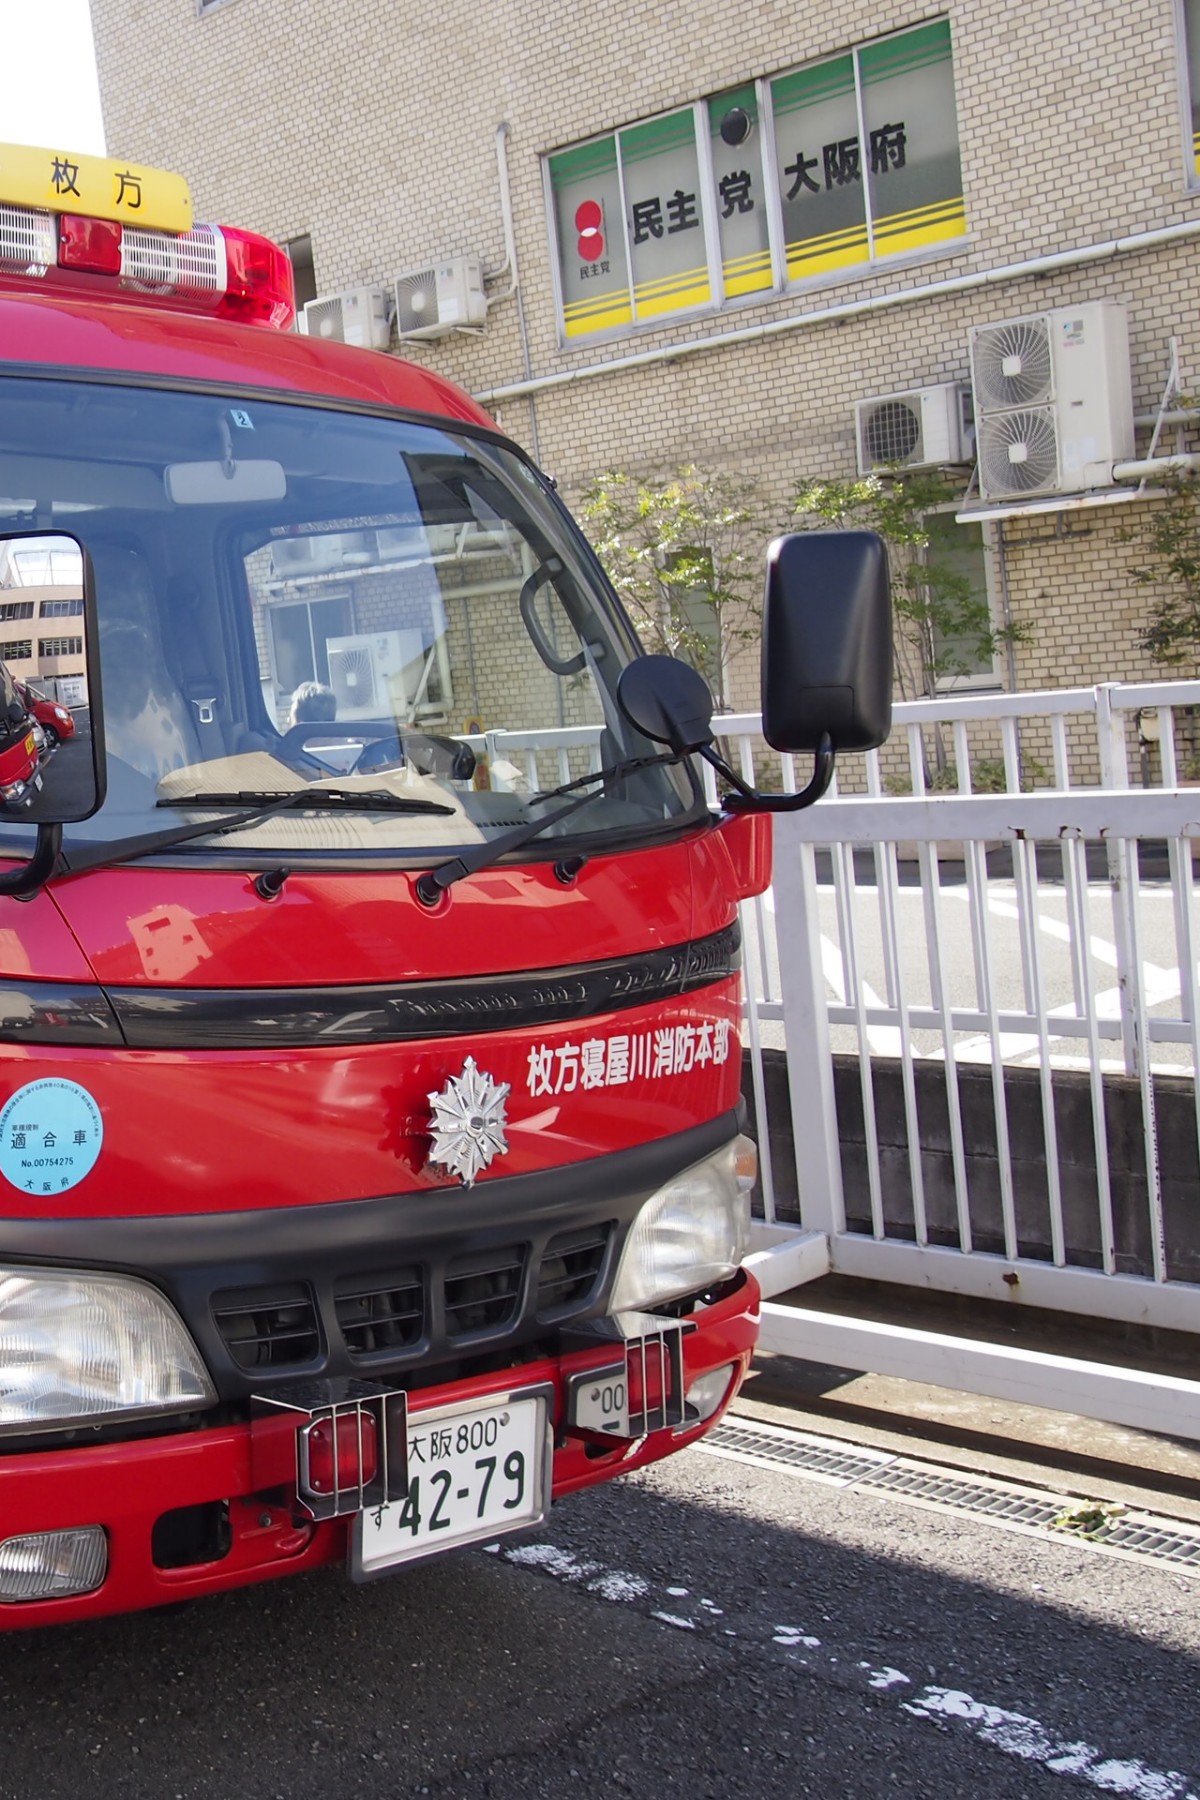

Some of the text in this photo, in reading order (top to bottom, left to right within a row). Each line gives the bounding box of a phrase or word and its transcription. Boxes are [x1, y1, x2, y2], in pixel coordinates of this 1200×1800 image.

[51, 156, 142, 208] 枚方
[632, 122, 907, 245] 民主党 大阪府
[580, 260, 610, 280] 民主党
[526, 1018, 730, 1098] 枚方寝屋川消防本部
[399, 1450, 526, 1537] 42-79
